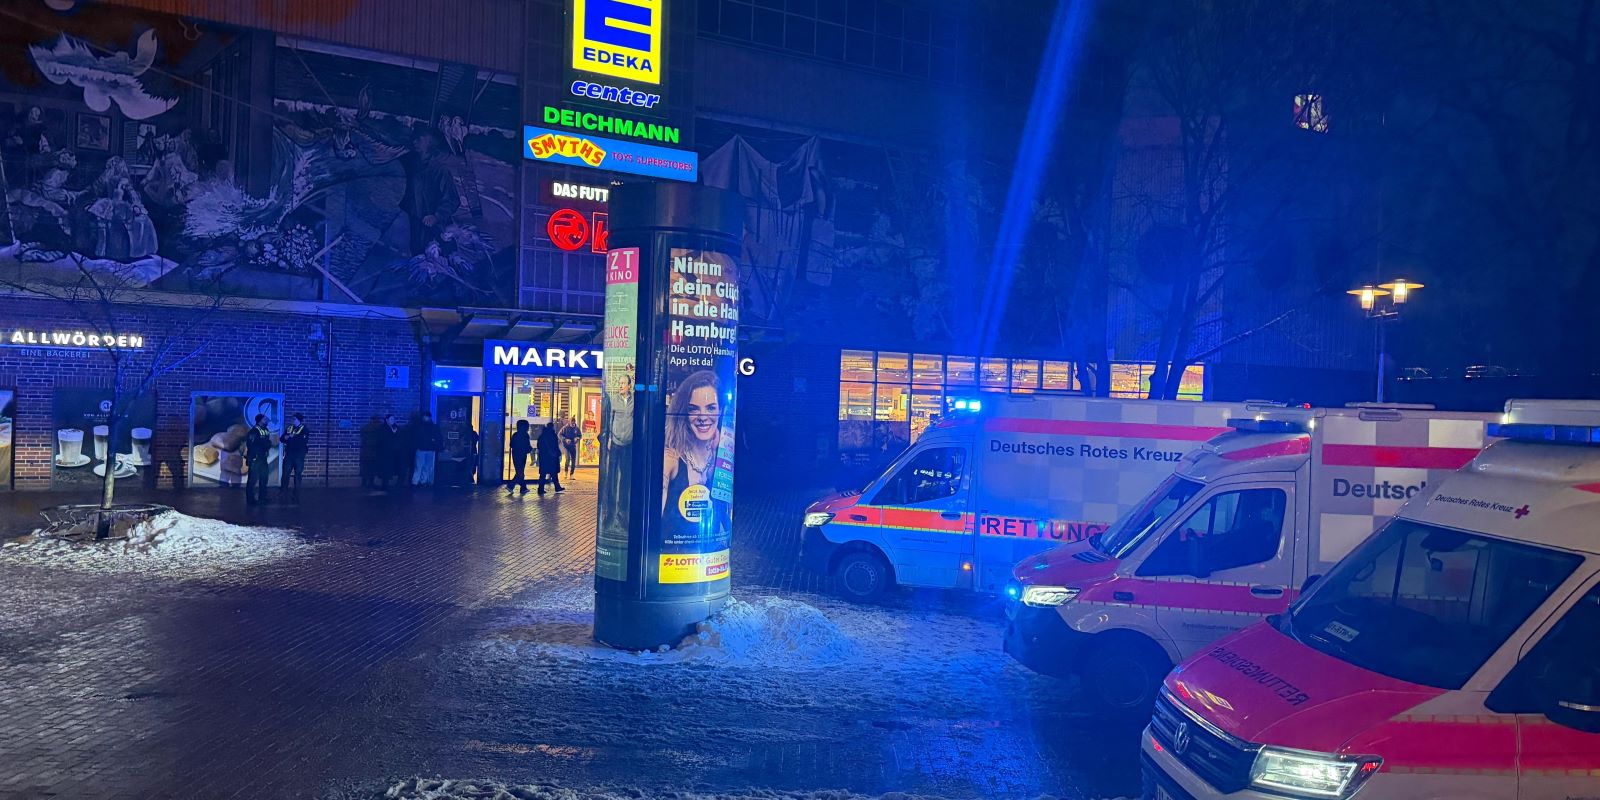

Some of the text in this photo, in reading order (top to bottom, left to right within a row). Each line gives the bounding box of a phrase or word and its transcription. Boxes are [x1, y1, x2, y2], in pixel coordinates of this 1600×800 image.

[583, 46, 653, 73] EDEKA
[571, 79, 660, 108] center
[544, 106, 680, 144] DEICHMANN
[531, 134, 605, 166] SMYTHS
[612, 152, 693, 172] TOYS SUPERSTORES
[553, 182, 578, 199] DAS
[609, 270, 632, 281] KINO
[674, 256, 722, 277] Nimm
[673, 278, 711, 296] dein
[672, 298, 689, 316] in
[693, 301, 718, 318] die
[11, 331, 143, 348] ALLWÖRDEN
[670, 345, 685, 353] Die
[687, 345, 712, 354] LOTTO
[20, 348, 42, 357] EINE
[670, 356, 713, 367] App ist da!
[990, 439, 1183, 463] Deutsches Rotes Kreuz
[1333, 478, 1426, 500] Deutsc
[1434, 494, 1514, 513] Deutsches Rotes Kreuz
[986, 517, 1110, 541] RETTUNG
[675, 557, 702, 566] LOTTO
